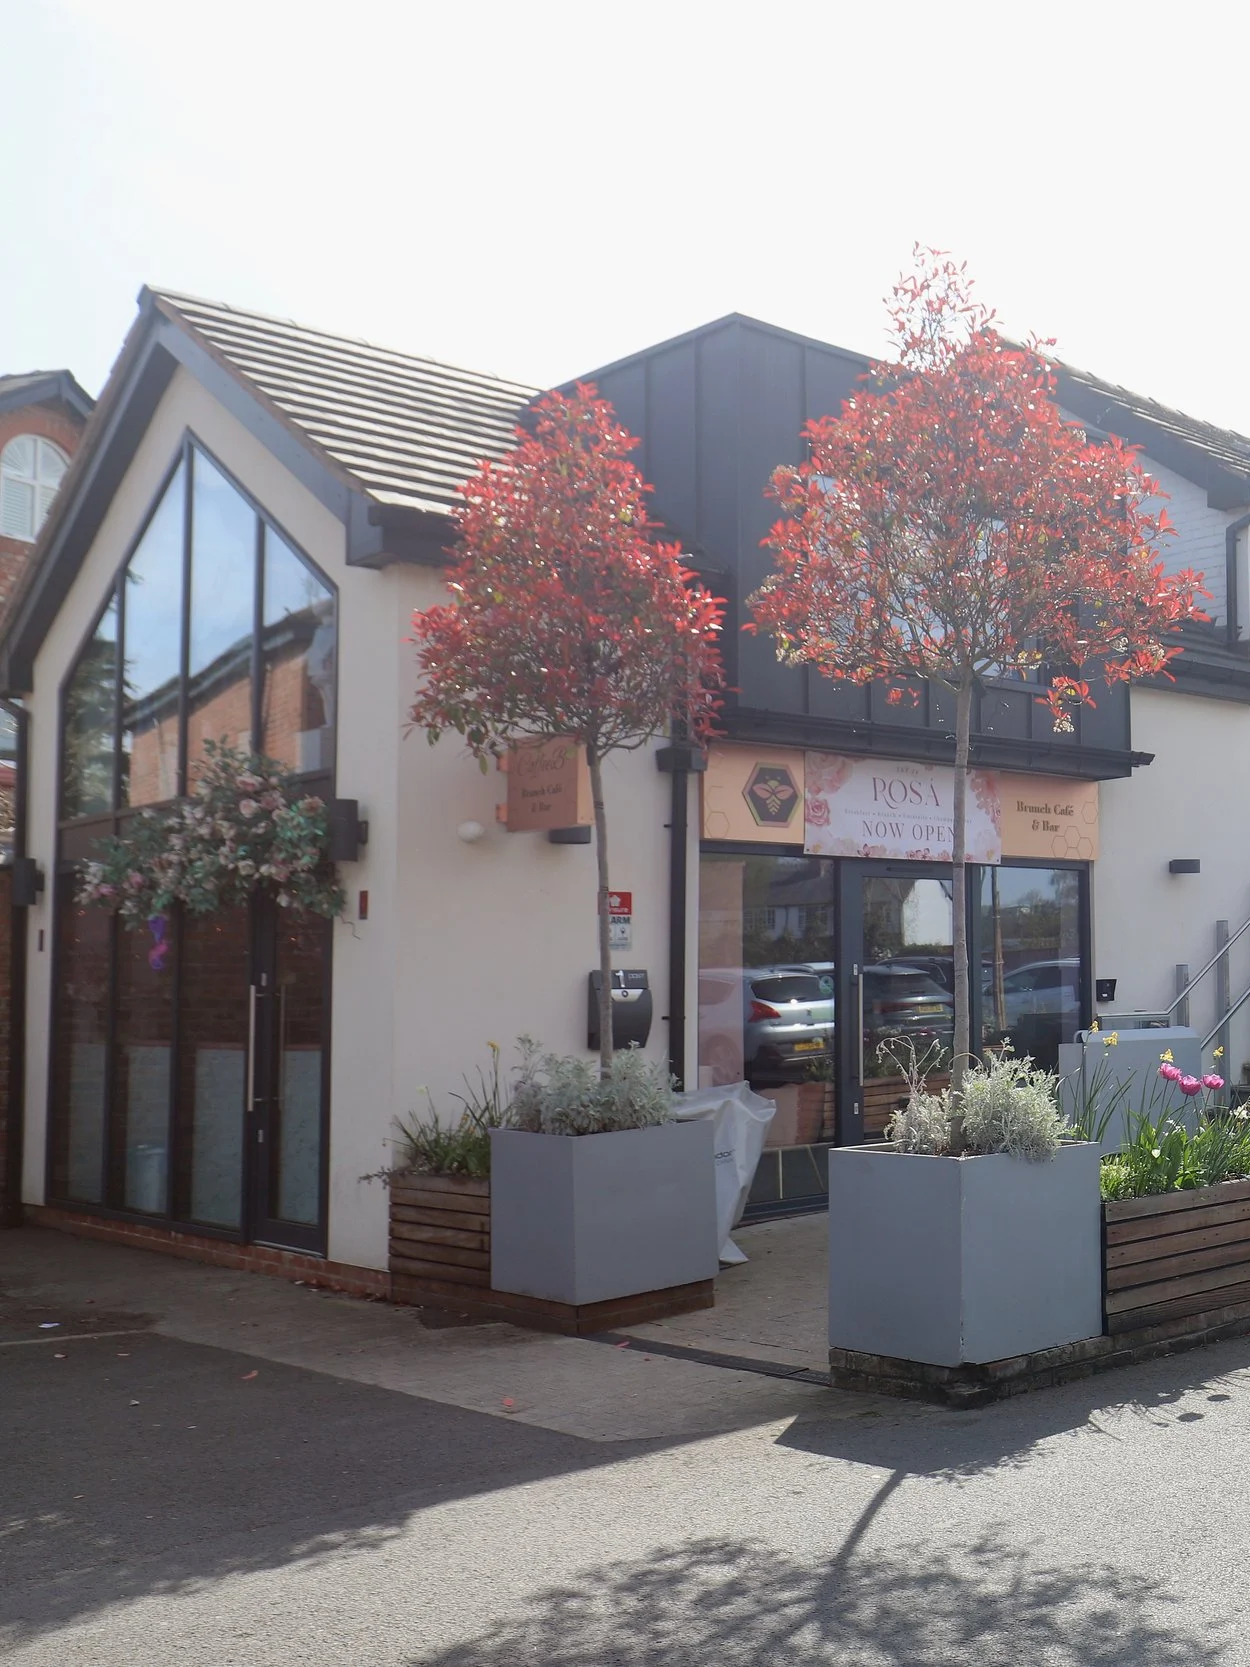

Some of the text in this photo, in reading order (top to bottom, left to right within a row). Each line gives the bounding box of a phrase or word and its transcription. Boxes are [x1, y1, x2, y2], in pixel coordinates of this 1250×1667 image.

[1016, 800, 1074, 816] Brunch Café
[862, 820, 904, 839] NOW
[1031, 819, 1060, 832] & Bar
[610, 916, 630, 924] ARM
[615, 970, 626, 988] 1
